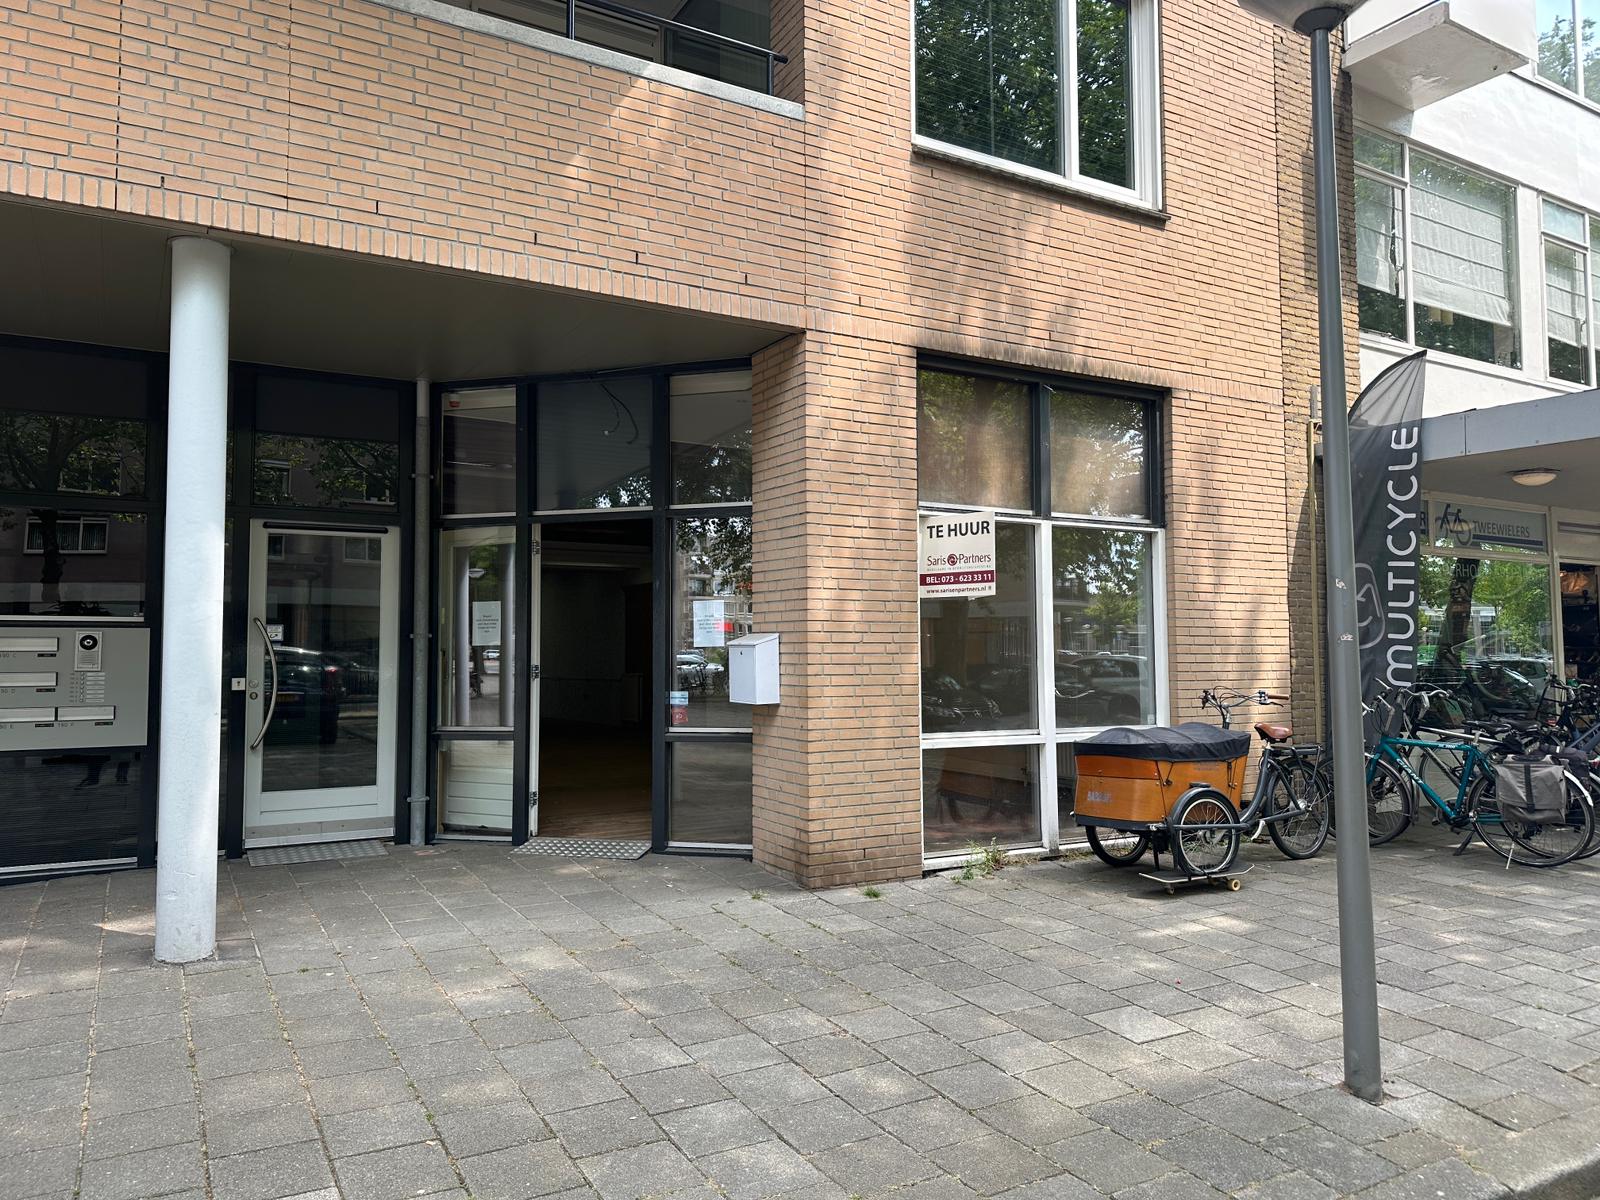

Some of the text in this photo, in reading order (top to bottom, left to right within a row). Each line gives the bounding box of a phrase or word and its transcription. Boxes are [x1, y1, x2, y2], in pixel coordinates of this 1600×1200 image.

[927, 520, 990, 538] TE HUUR
[1472, 520, 1530, 538] TWEEWIELERS
[927, 553, 992, 567] Saris Partners
[1386, 426, 1419, 687] MULTICYCLE
[926, 576, 940, 584] BEL:
[941, 575, 954, 583] 073
[959, 574, 972, 582] 623
[973, 573, 982, 581] 33
[983, 573, 992, 581] 11
[926, 586, 986, 594] www.sarisenpartners.nl
[1396, 758, 1425, 785] GIANT
